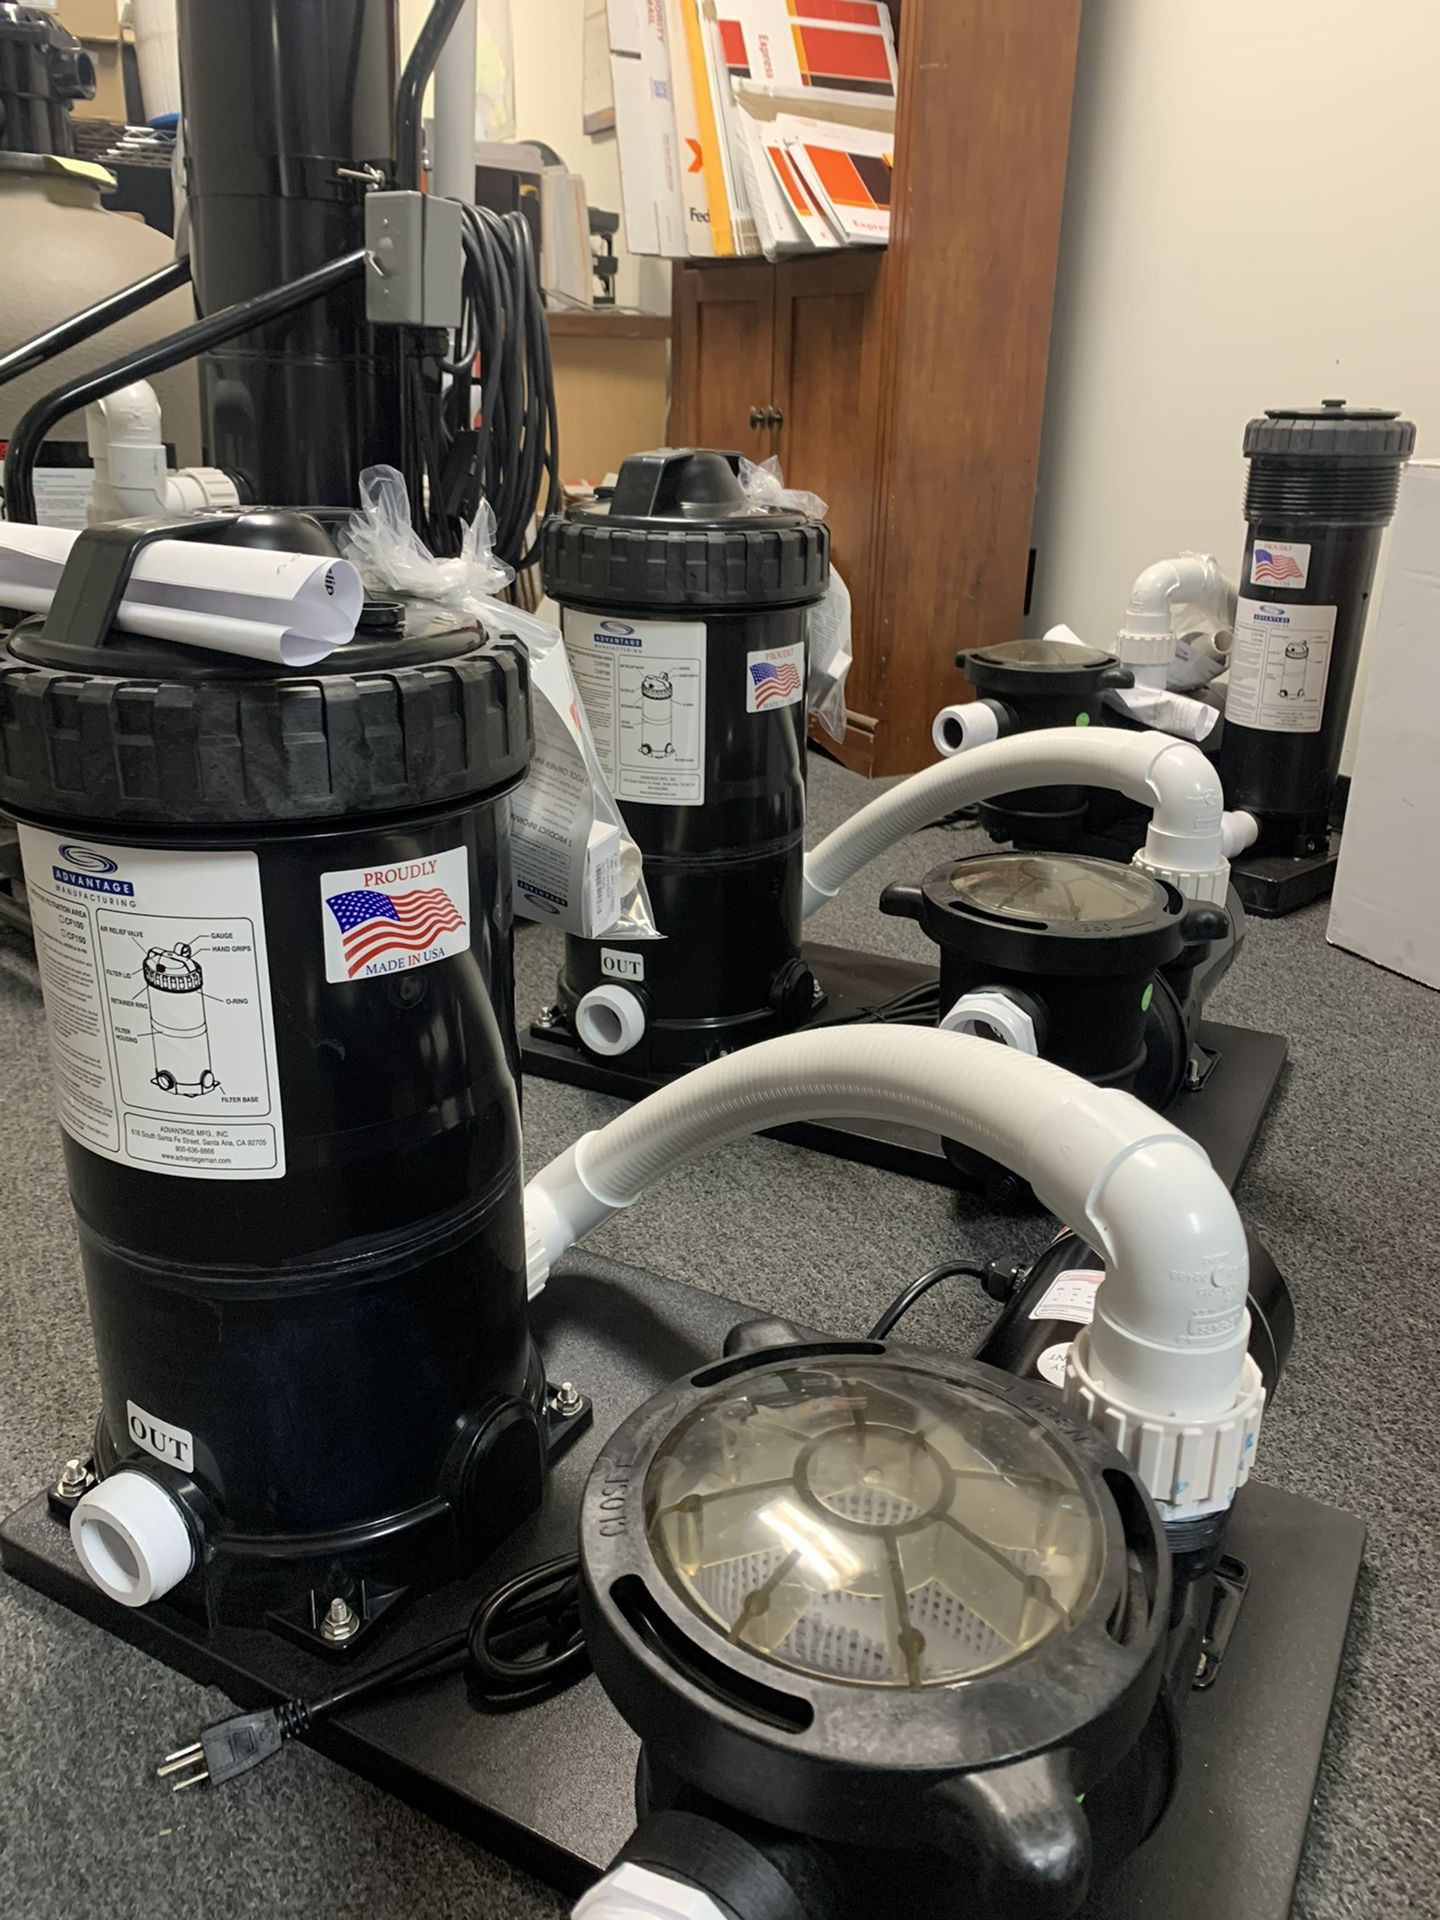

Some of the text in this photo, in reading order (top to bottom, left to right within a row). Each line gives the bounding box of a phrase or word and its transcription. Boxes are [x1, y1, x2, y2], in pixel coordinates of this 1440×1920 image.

[758, 34, 774, 79] Express
[595, 634, 641, 647] ADVANTAGE
[55, 869, 131, 894] ADVANTAGE
[363, 859, 437, 888] PROUDLY
[55, 884, 136, 908] MANUFACTURING
[109, 927, 127, 936] RELIEF
[127, 930, 144, 938] VALVE
[365, 947, 446, 976] MADE IN USA
[603, 956, 641, 975] OUT
[106, 969, 123, 978] FILTER
[111, 997, 148, 1010] RETAINER RING
[115, 1027, 131, 1035] FILTER
[115, 1034, 138, 1044] HOUSING
[141, 1129, 156, 1139] South
[157, 1133, 173, 1143] Santa
[202, 1138, 220, 1146] Santa
[160, 1125, 195, 1136] ADVANTAGE
[130, 1415, 189, 1463] OUT
